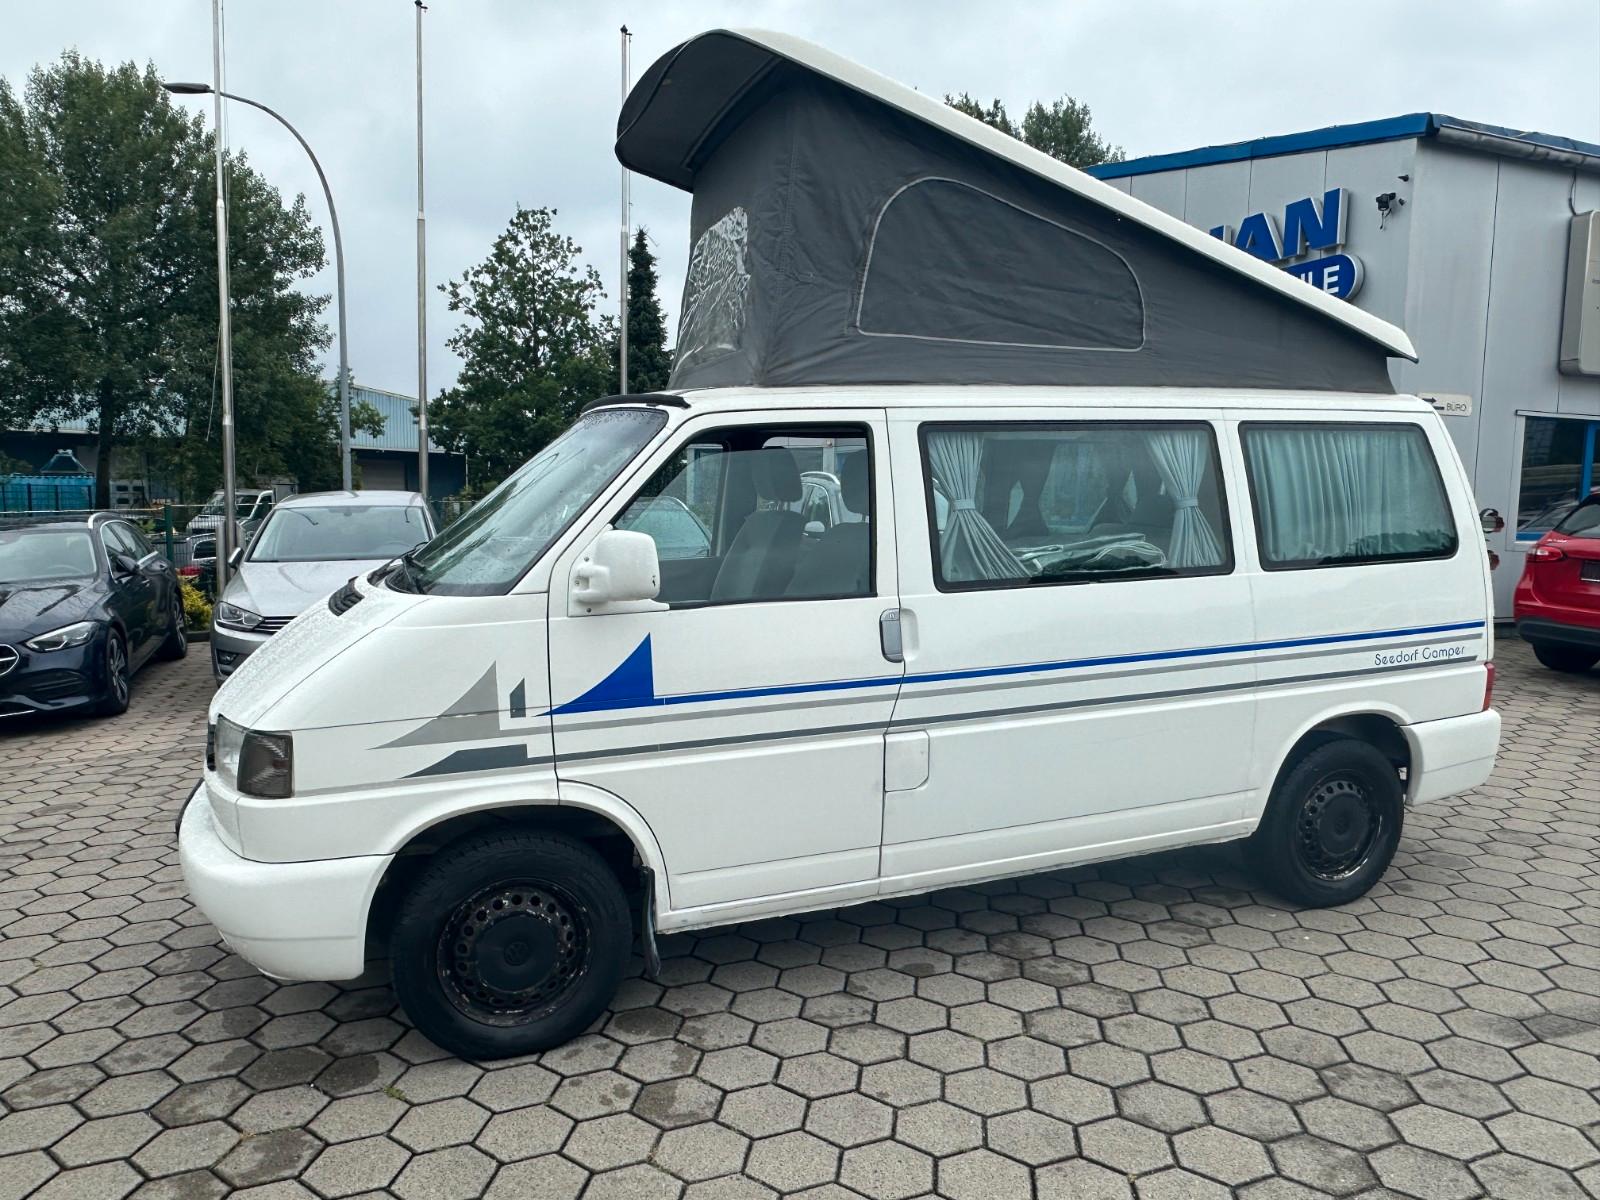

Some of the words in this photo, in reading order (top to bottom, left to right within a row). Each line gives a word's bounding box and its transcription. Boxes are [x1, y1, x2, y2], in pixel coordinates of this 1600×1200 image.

[1209, 187, 1344, 261] AN
[1446, 401, 1467, 412] BÜRO
[1374, 649, 1418, 665] Seedorf
[1422, 646, 1465, 660] Camper
